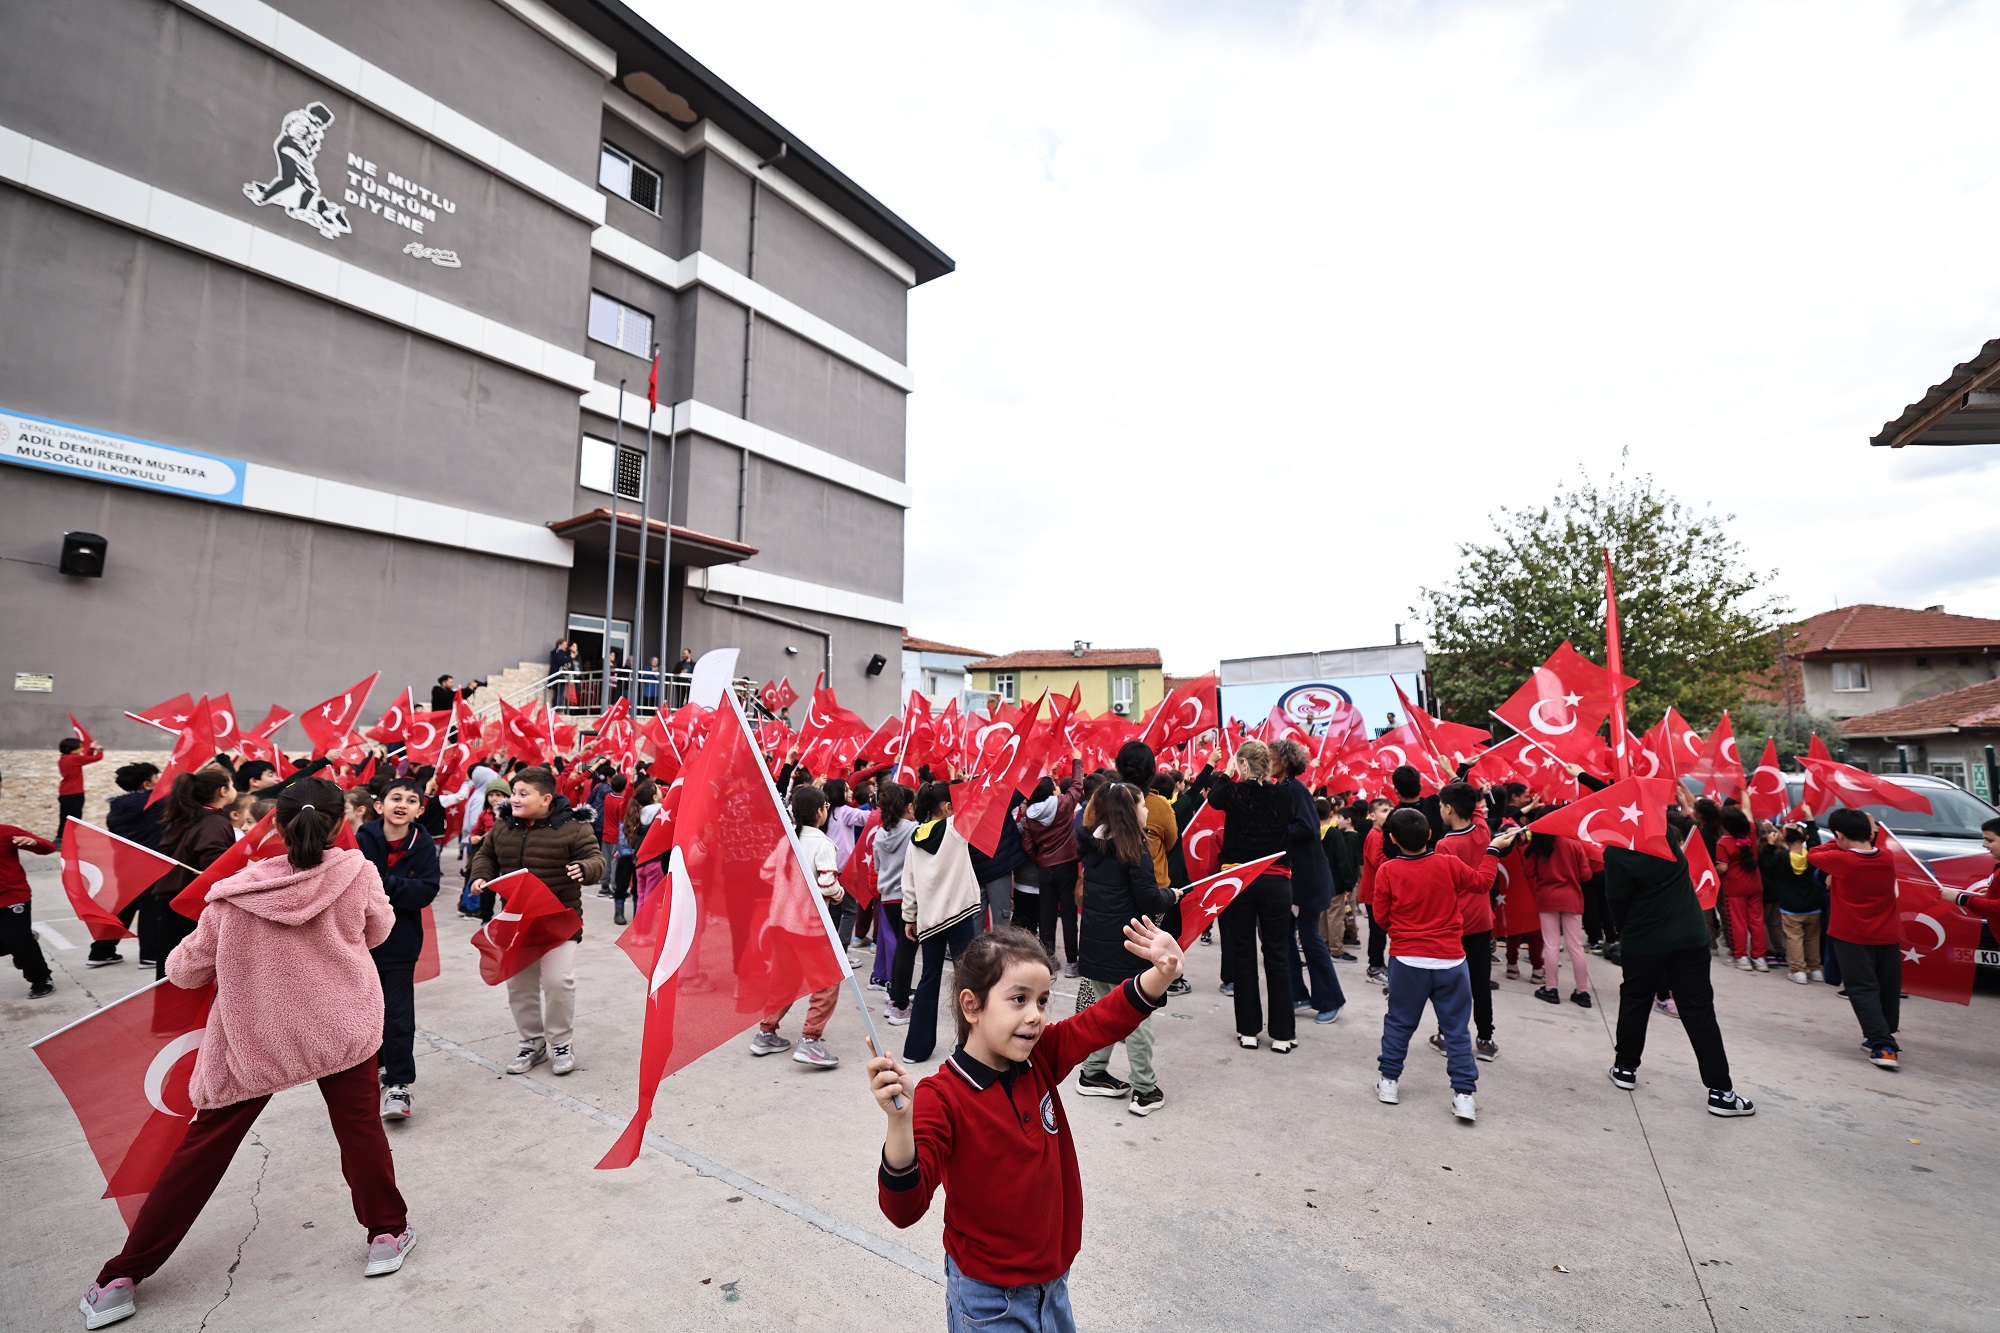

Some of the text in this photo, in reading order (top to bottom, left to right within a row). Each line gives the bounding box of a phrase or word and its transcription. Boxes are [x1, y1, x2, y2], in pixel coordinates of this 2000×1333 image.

[347, 152, 456, 214] NE MUTLU
[347, 171, 436, 222] TÜRKÜM
[344, 188, 424, 234] DİYENE
[16, 446, 166, 483] MUSOĞLU İLKOKULU
[19, 433, 206, 479] ADİL DEMİREREN MUSTAFA
[1981, 951, 1999, 964] KD
